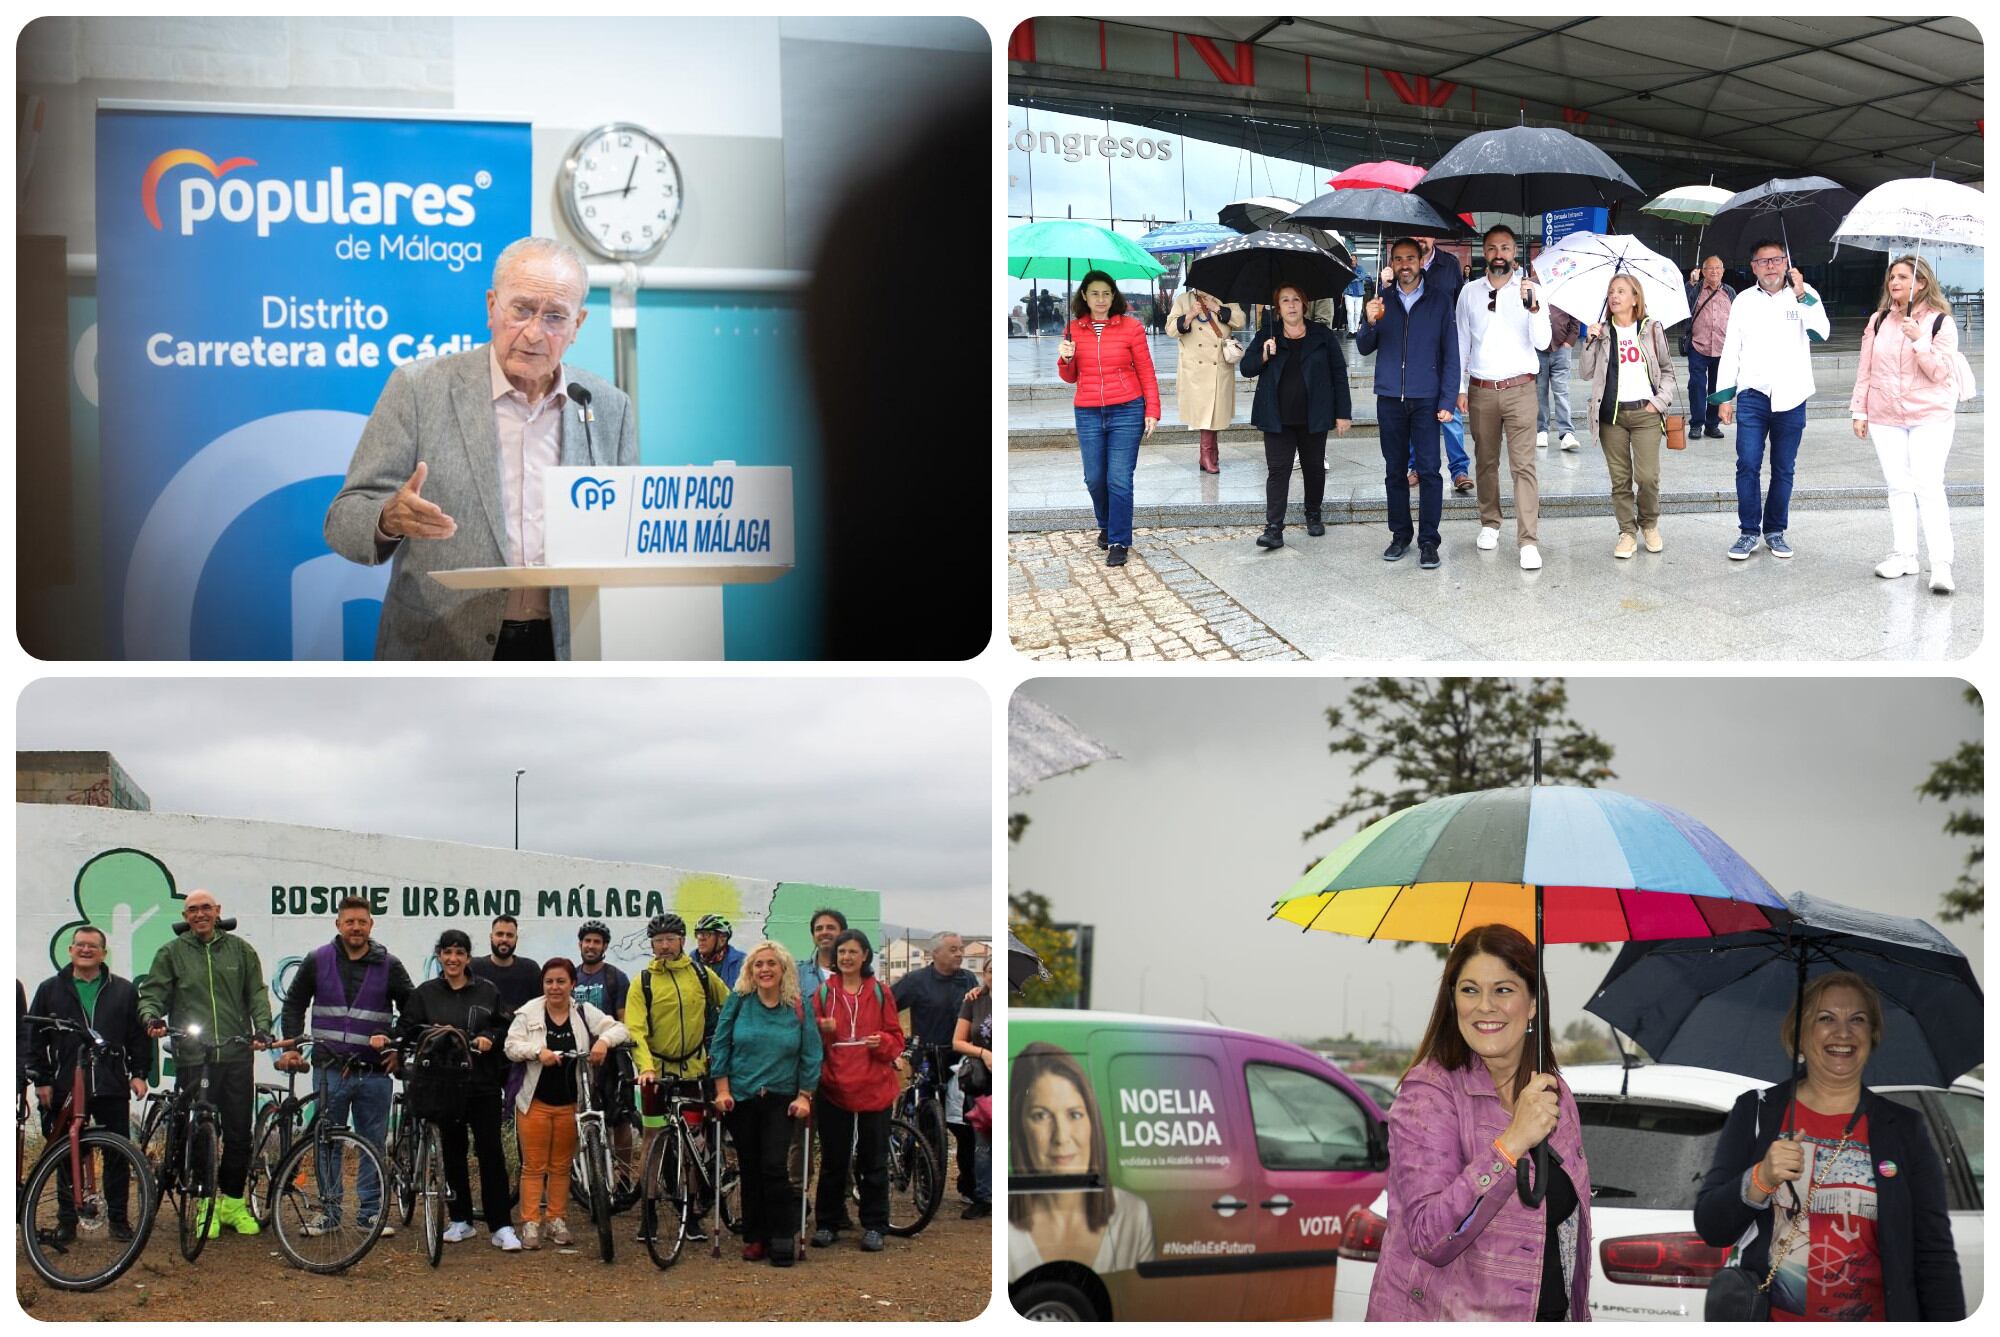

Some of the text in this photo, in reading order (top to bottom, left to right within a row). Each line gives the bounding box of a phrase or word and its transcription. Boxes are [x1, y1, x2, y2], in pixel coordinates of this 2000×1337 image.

[1008, 121, 1172, 162] ongresos
[180, 166, 475, 238] populares
[335, 234, 482, 273] de Málaga
[262, 296, 389, 330] Distrito
[146, 333, 488, 368] Carretera de Cádi
[641, 476, 681, 510] CON
[684, 476, 734, 510] PACO
[637, 513, 771, 553] GANA MÁLAGA
[402, 886, 521, 917] URBANO
[538, 884, 664, 917] MÁLAGA
[1119, 1088, 1215, 1114] NOELIA
[1119, 1121, 1222, 1147] LOSADA
[1299, 1216, 1342, 1236] VOTA
[1163, 1240, 1256, 1255] #NoeliaEsFuturo
